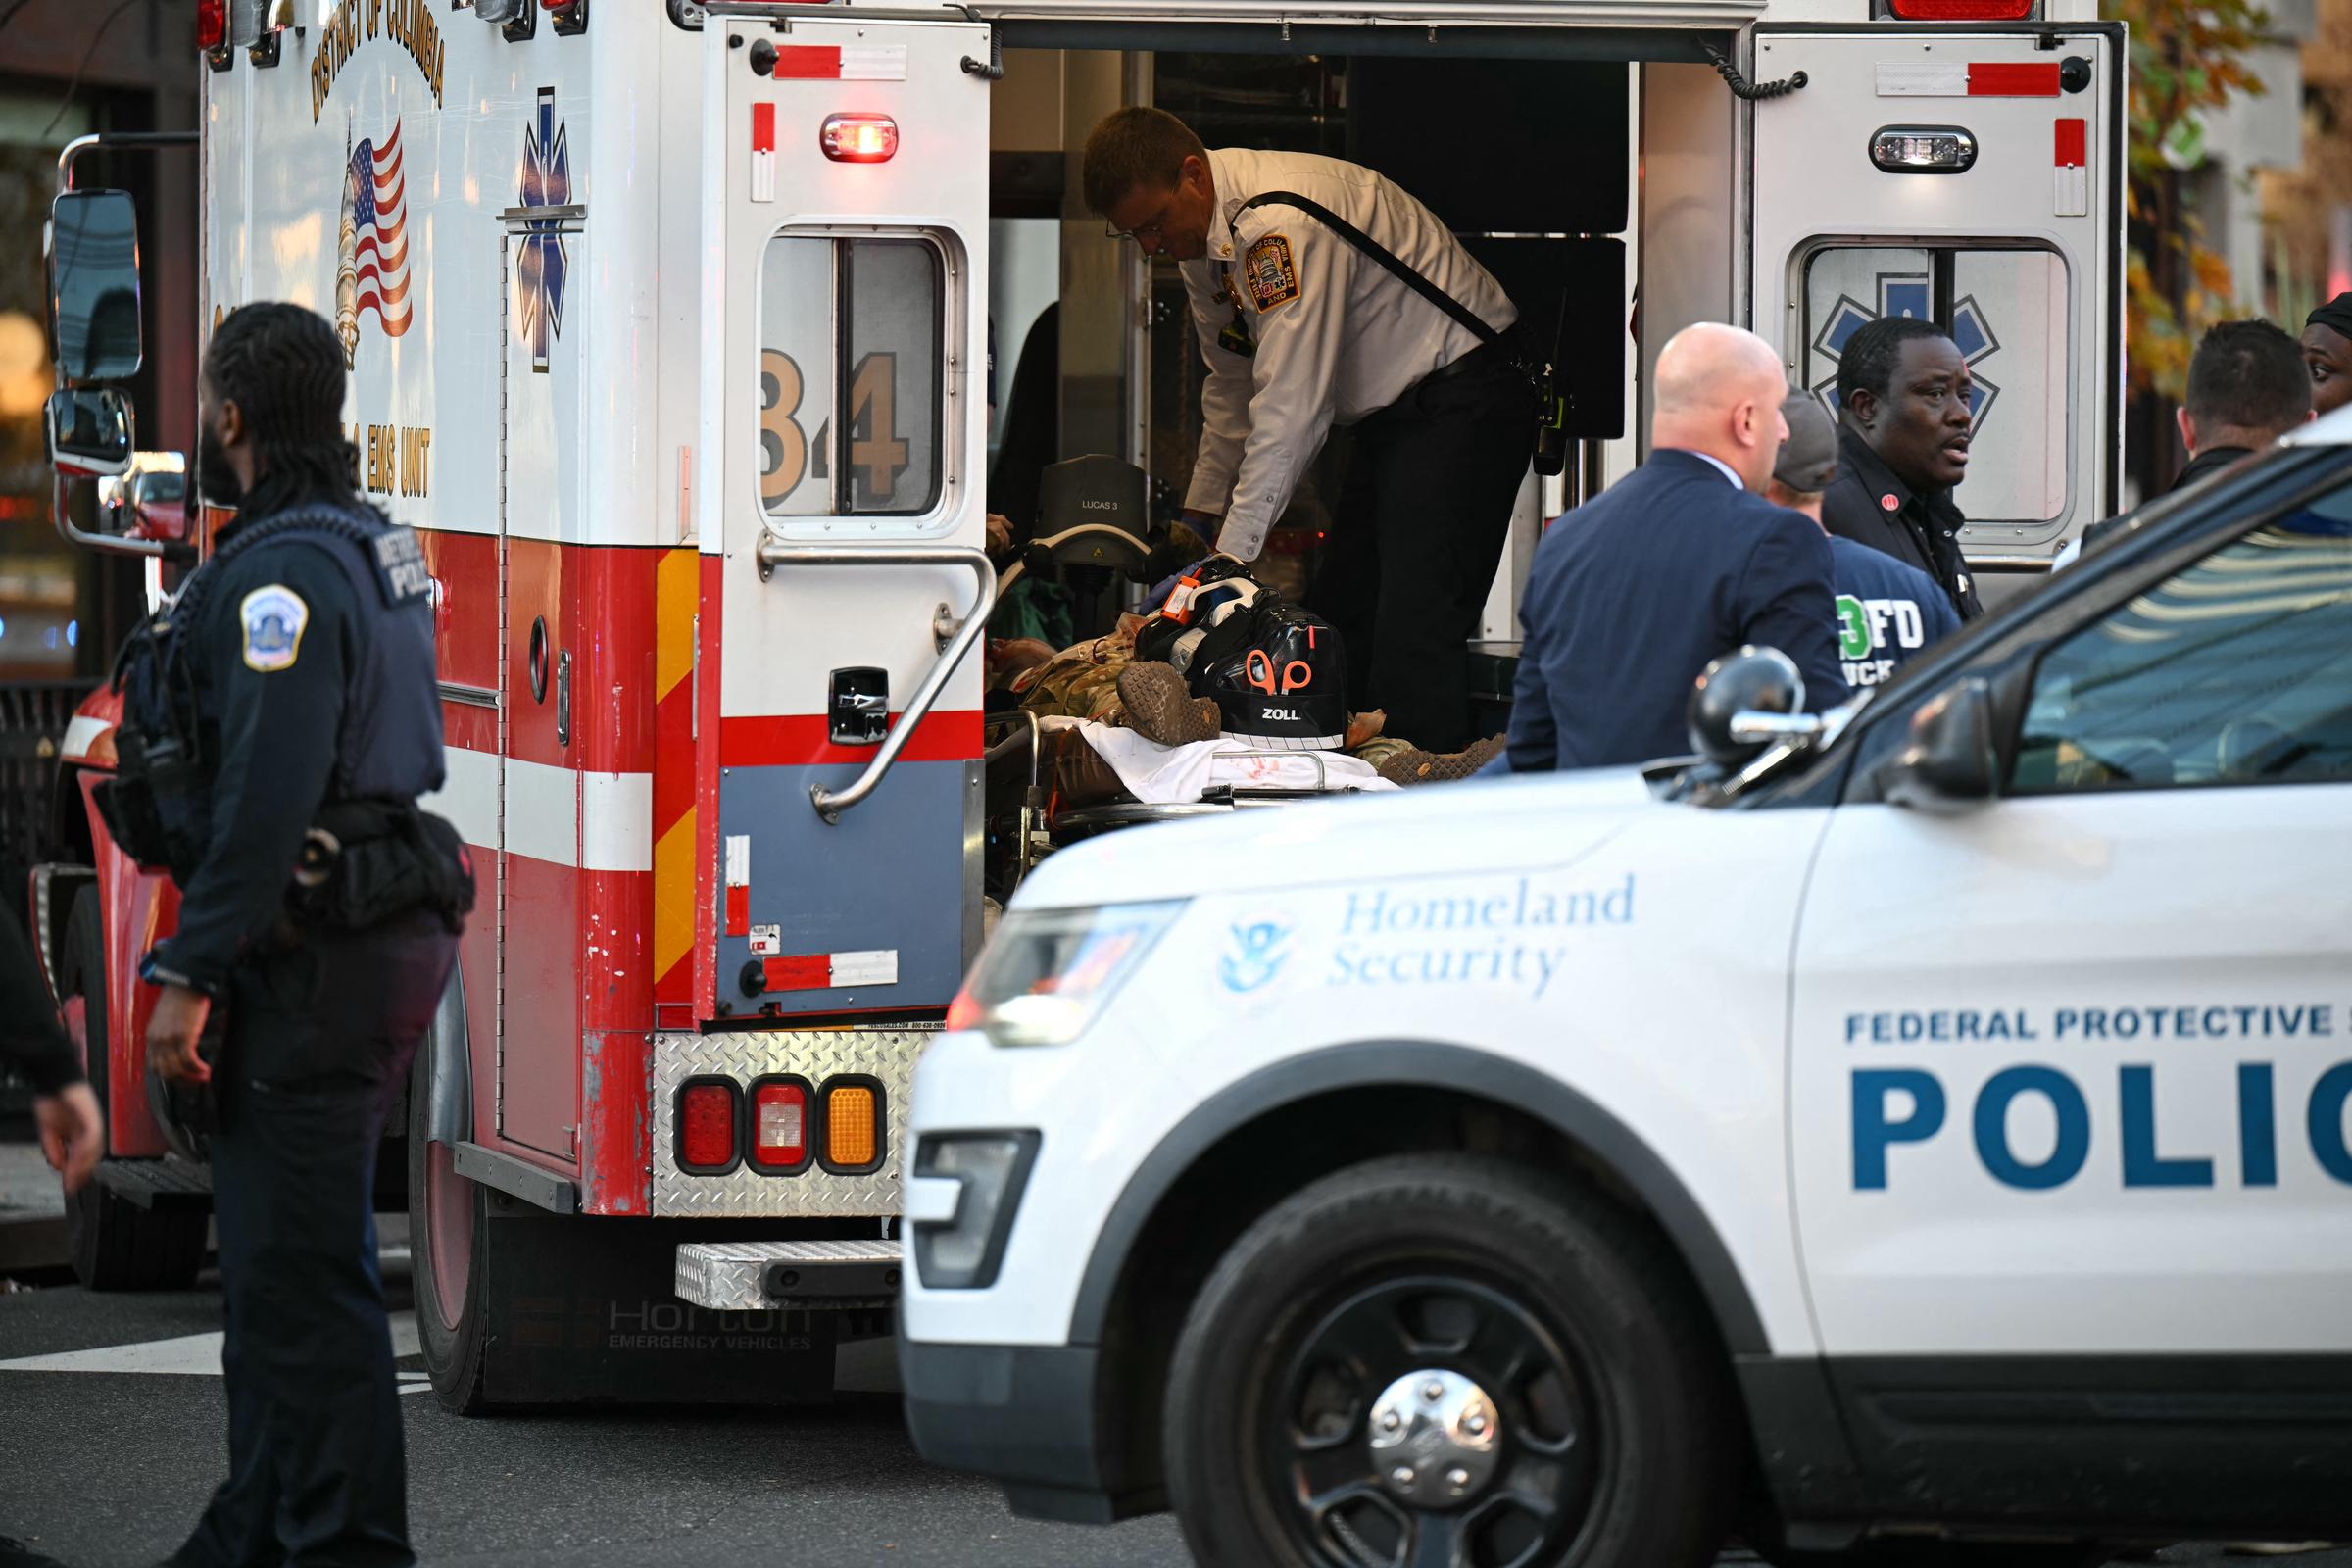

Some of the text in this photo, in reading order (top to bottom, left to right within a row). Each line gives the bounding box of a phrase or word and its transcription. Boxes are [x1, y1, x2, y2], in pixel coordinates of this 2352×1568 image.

[311, 0, 362, 126] DISTRICT
[386, 0, 445, 111] COLUMBIA
[1264, 238, 1288, 261] COLUMBIA
[1250, 266, 1294, 304] FIRE AND EMS
[368, 424, 395, 497] EMS
[401, 426, 430, 498] UNIT
[1082, 500, 1118, 511] LUCAS 3
[1262, 707, 1299, 721] ZOLL
[1340, 871, 1636, 935] Homeland
[1324, 936, 1568, 1001] Security
[1844, 1010, 2038, 1045] FEDERAL
[2054, 1004, 2333, 1039] PROTECTIVE
[609, 1334, 811, 1349] EMERGENCY VEHICLES
